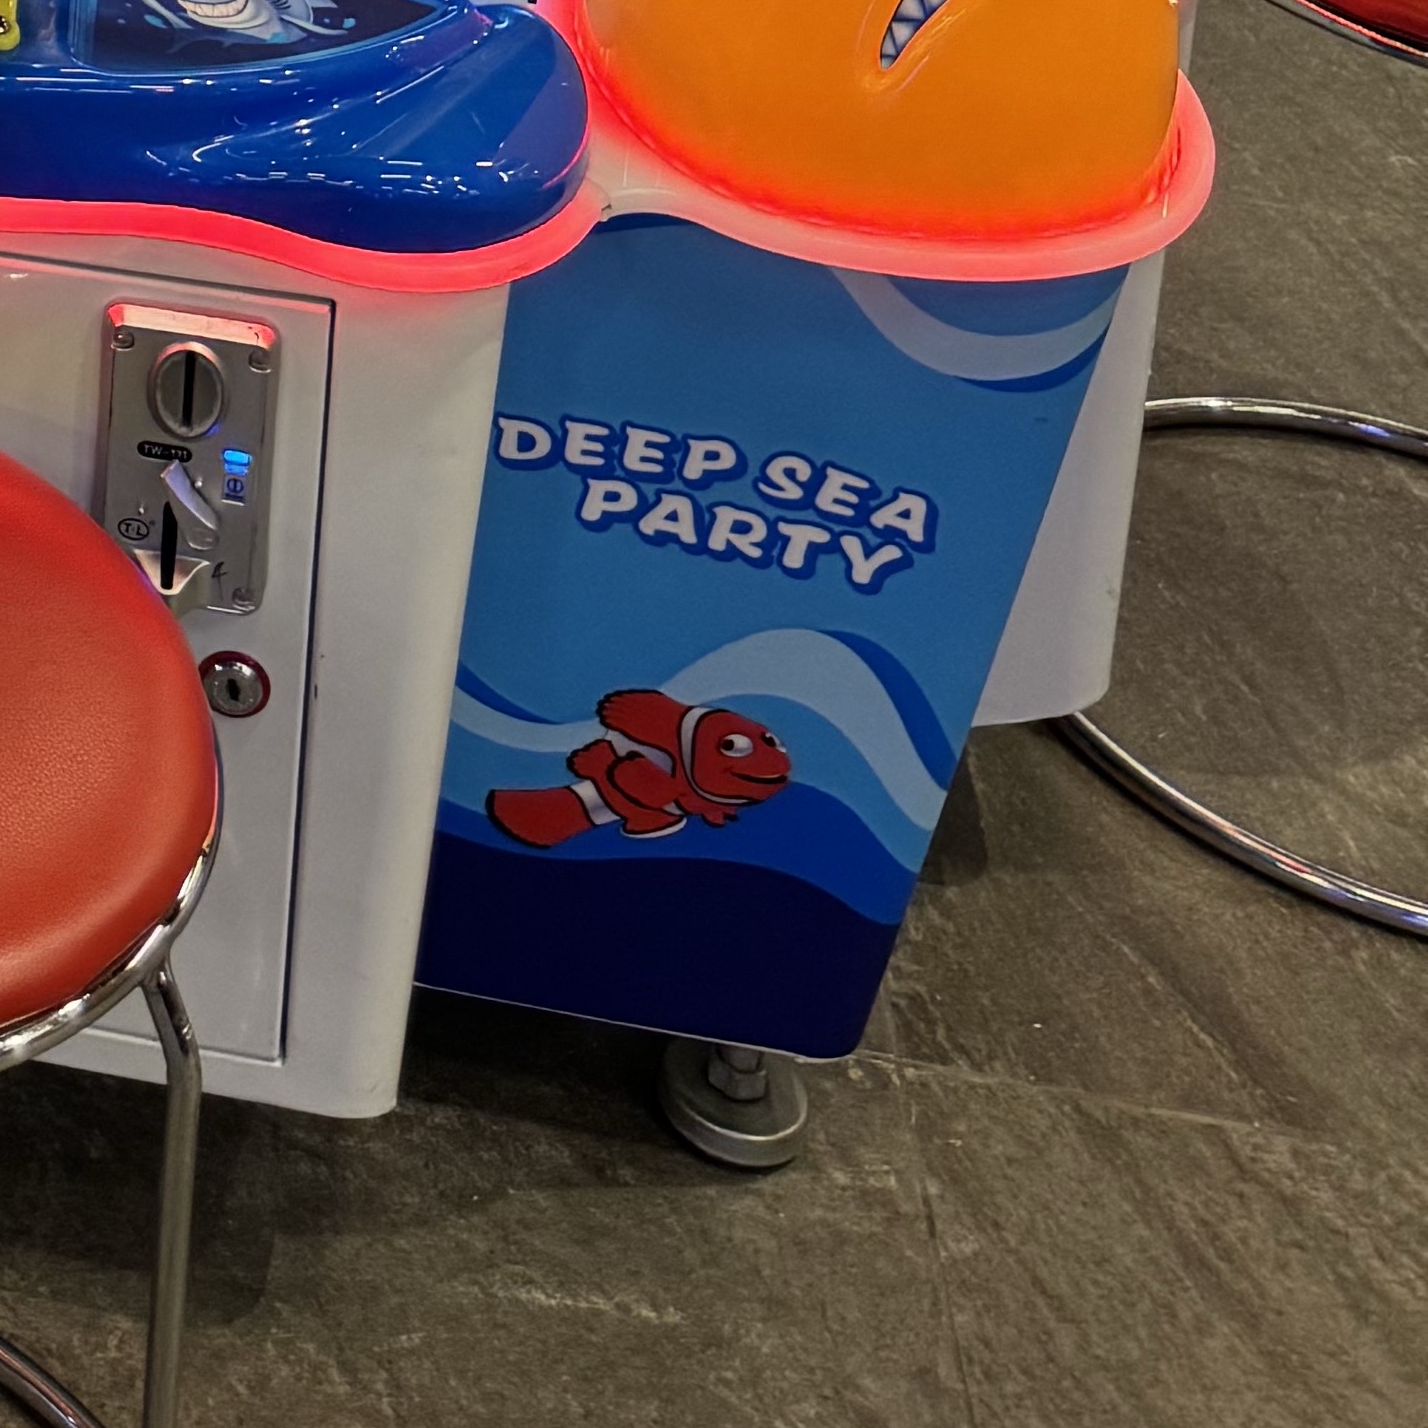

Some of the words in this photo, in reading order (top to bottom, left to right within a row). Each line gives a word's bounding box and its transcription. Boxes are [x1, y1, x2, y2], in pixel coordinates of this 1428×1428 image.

[498, 416, 738, 480] DEEP
[758, 455, 928, 544] SEA
[580, 478, 904, 585] PARTY
